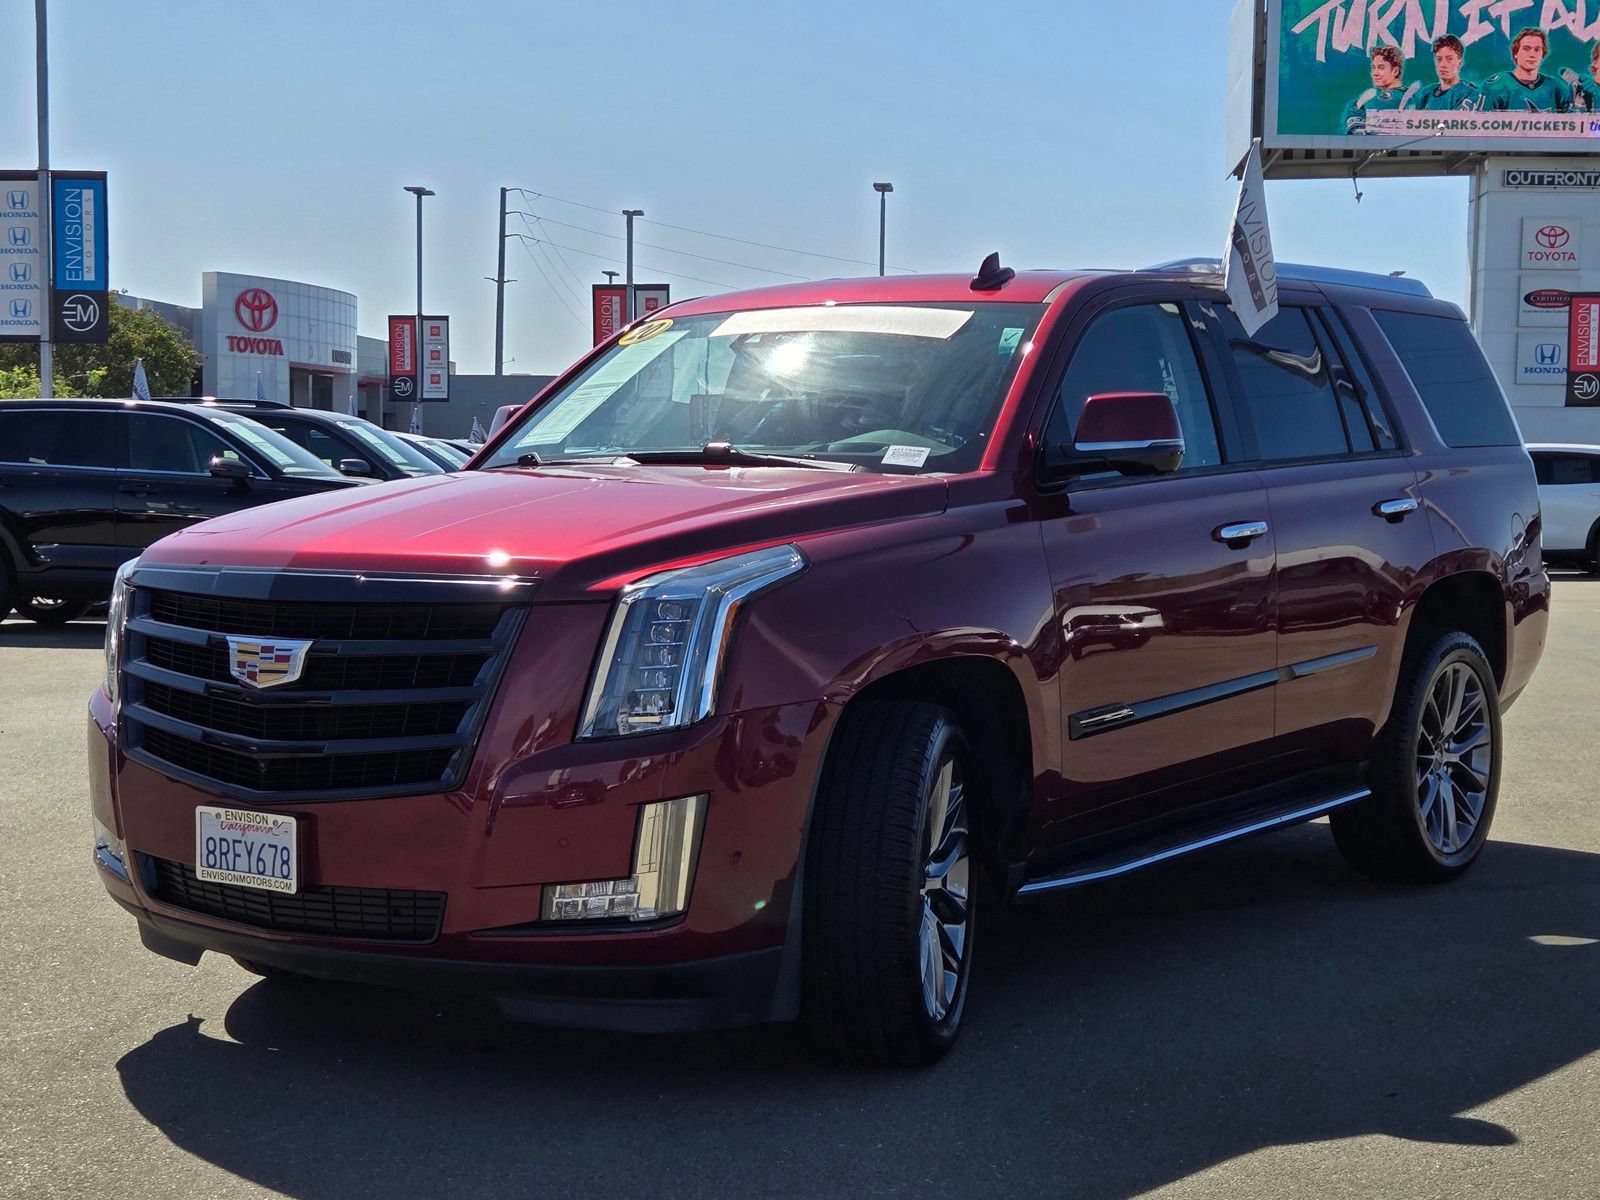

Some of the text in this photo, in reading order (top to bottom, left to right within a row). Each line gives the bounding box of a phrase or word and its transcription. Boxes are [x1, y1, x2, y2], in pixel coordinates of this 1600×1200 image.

[1291, 0, 1600, 62] TURN IT AL
[65, 188, 82, 281] ENVISION
[1237, 188, 1279, 304] NVISION
[1528, 252, 1577, 261] TOYOTA
[1235, 234, 1262, 300] TORS
[601, 295, 612, 340] VISION
[1576, 303, 1589, 366] ENVISION
[226, 335, 284, 355] TOYOTA
[395, 323, 404, 371] ENVISION
[224, 810, 269, 825] ENVISION
[201, 869, 292, 891] ENVISIONMOTORS.COM
[205, 836, 291, 879] 8RFY678
